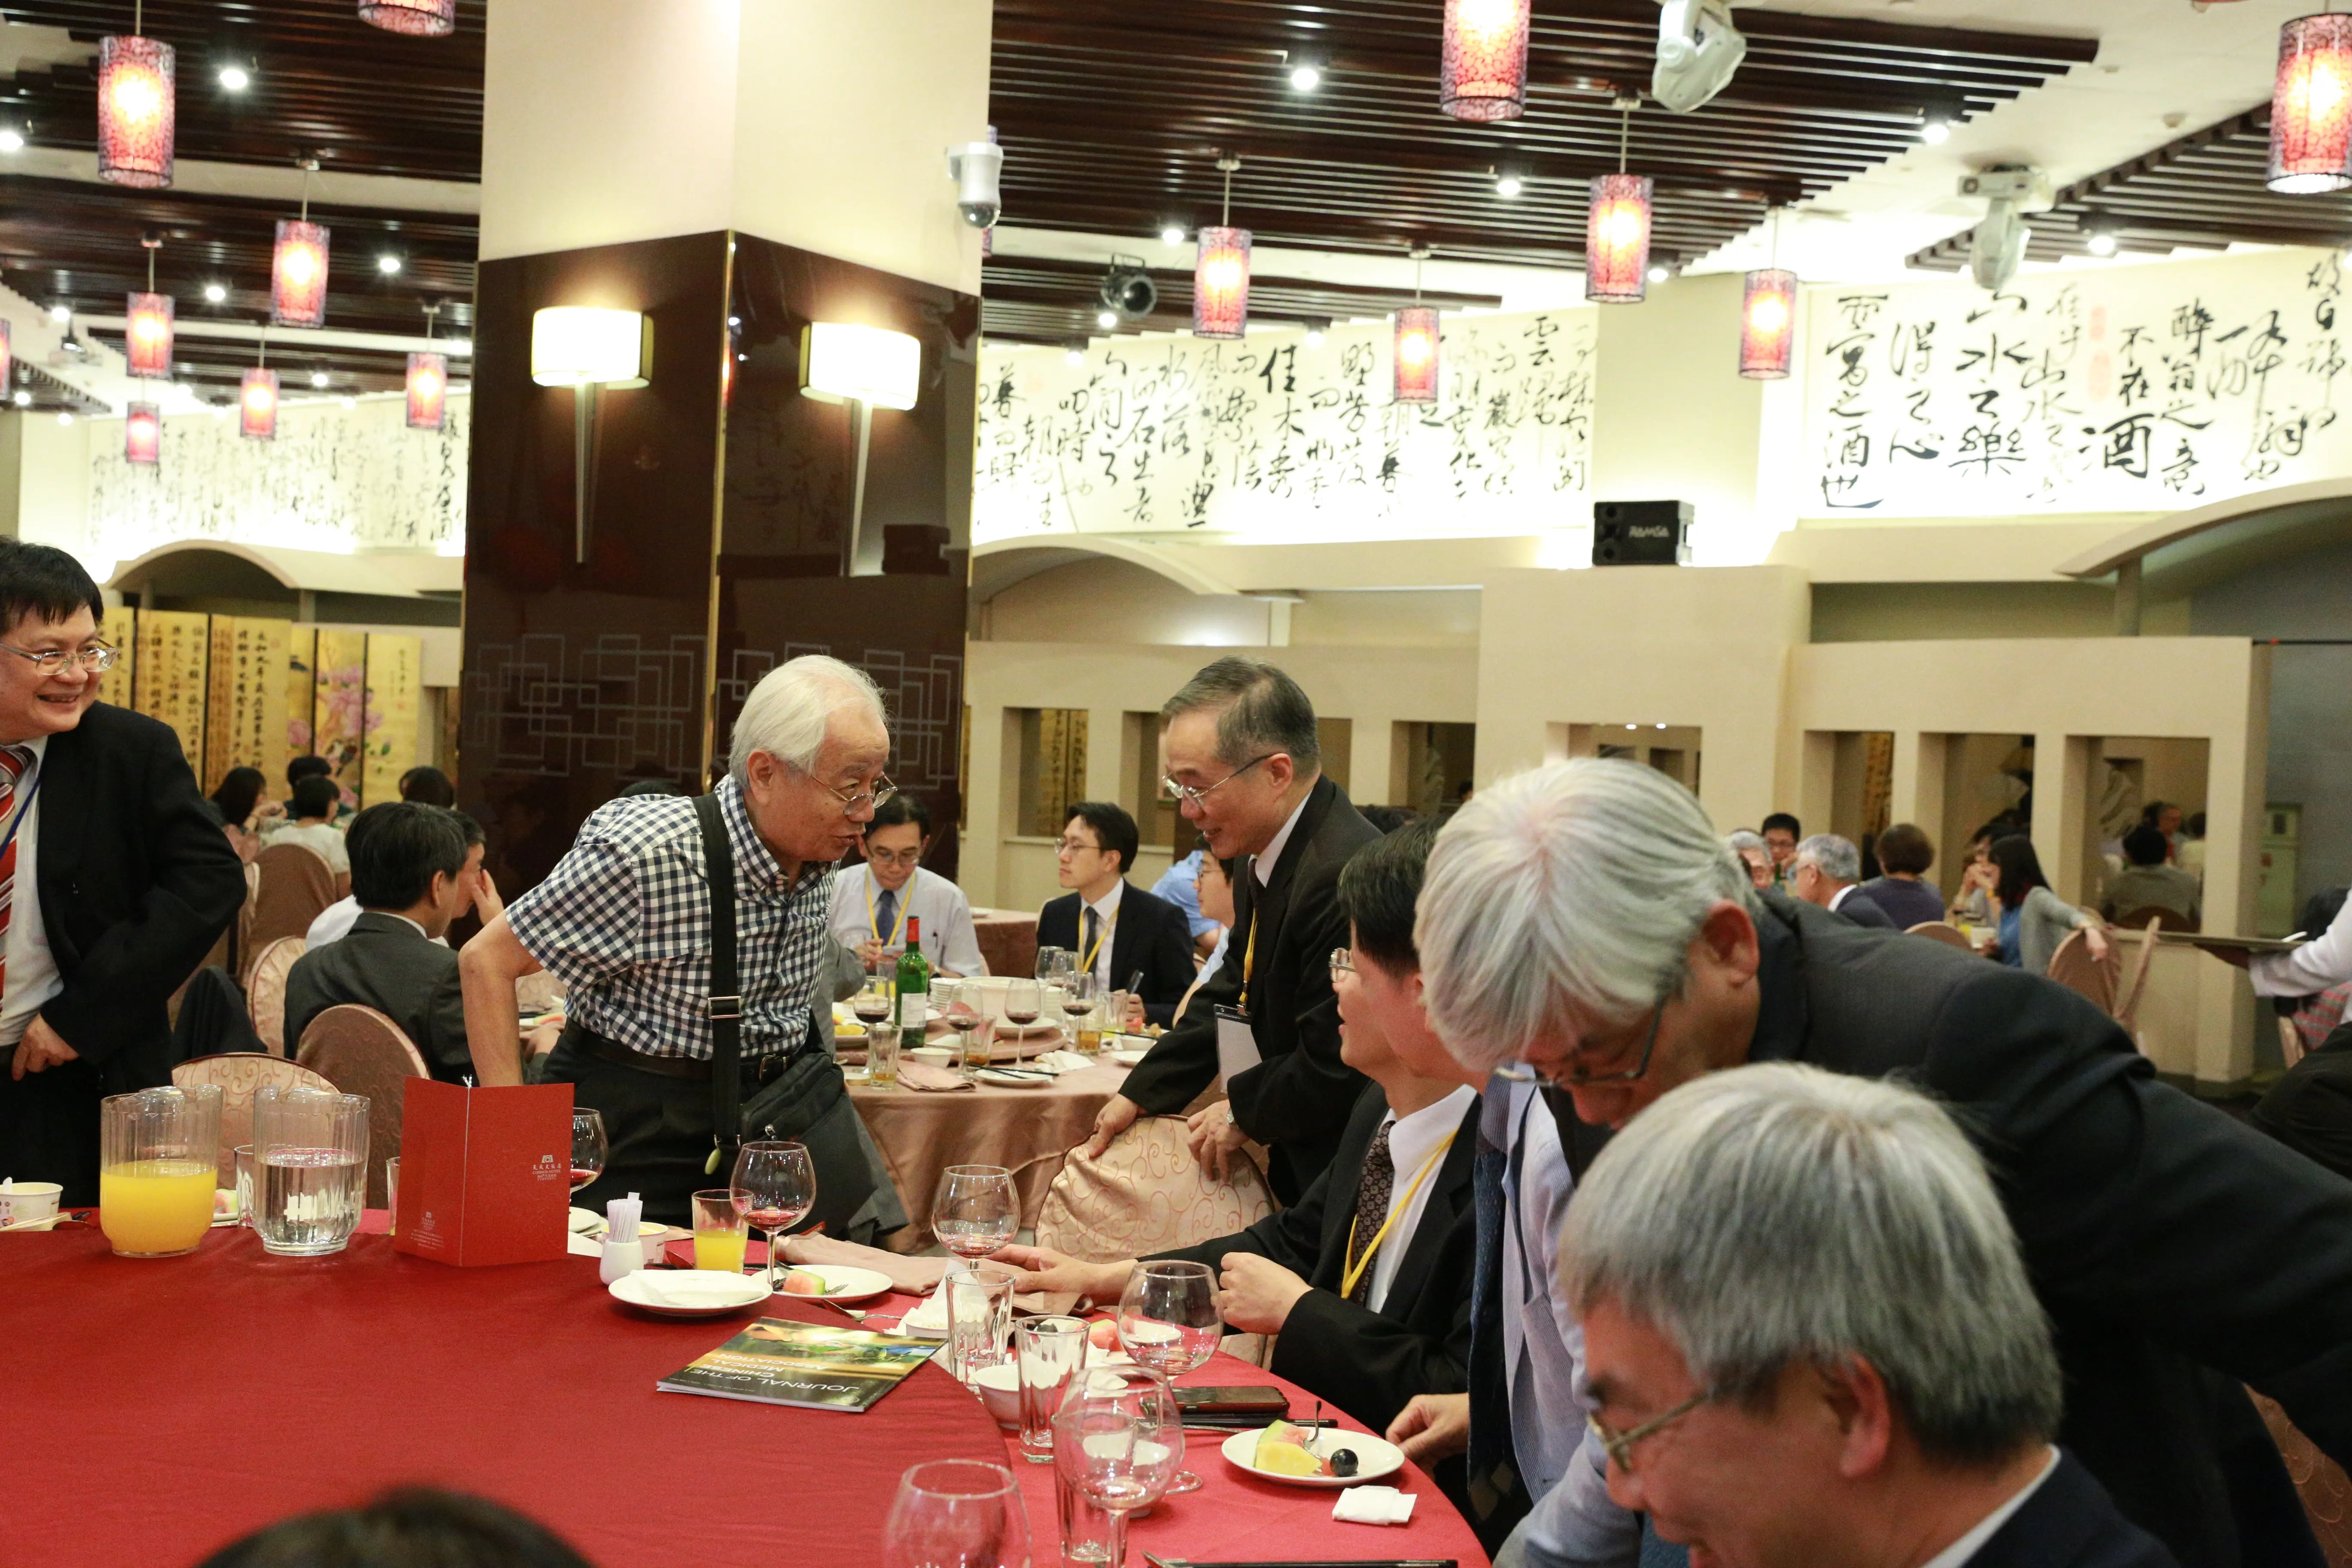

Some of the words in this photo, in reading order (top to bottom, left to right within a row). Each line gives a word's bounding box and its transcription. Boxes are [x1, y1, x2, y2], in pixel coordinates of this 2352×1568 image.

[1948, 290, 2034, 478] 山水之樂
[2078, 326, 2155, 478] 不在酒
[2162, 298, 2214, 496] 醉翁之意
[711, 1359, 786, 1372] MEDICAL
[719, 1354, 830, 1370] ASSOCIATION
[690, 1369, 723, 1378] THE
[700, 1364, 775, 1378] CHINESE
[757, 1378, 860, 1392] JOURNAL
